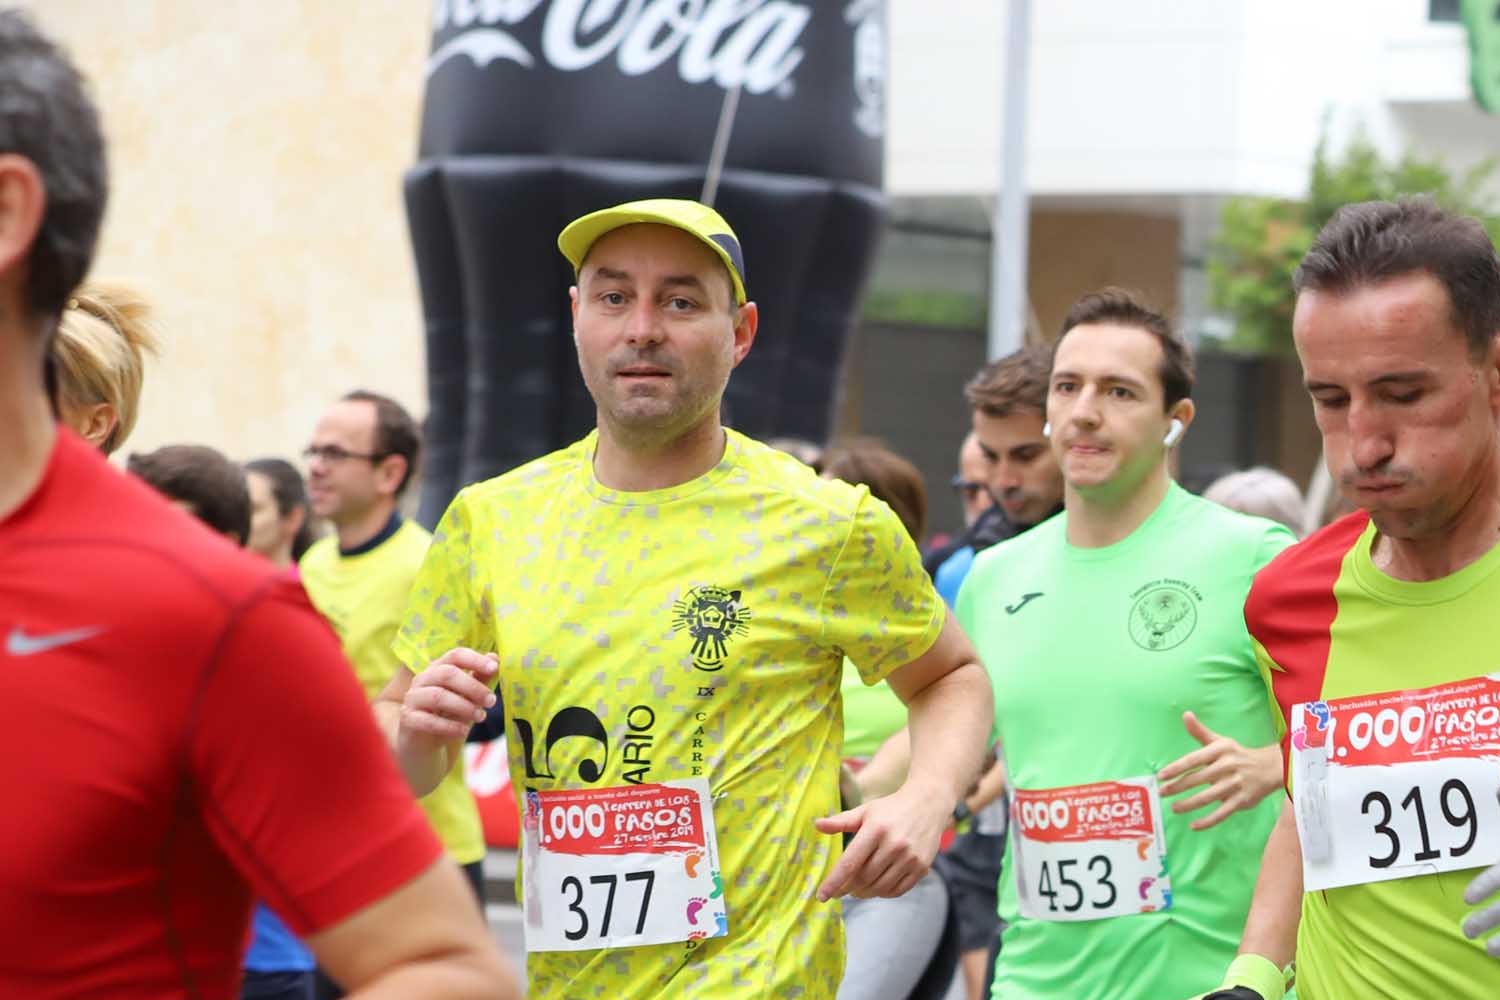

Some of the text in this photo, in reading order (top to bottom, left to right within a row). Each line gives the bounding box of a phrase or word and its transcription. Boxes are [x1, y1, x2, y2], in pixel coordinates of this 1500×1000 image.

[1431, 736, 1446, 749] 27
[654, 798, 666, 807] DE
[668, 795, 690, 805] LOS
[1077, 800, 1144, 823] PASOS
[614, 806, 692, 833] PASOS
[1360, 778, 1478, 868] 319
[613, 833, 628, 845] 27
[1038, 854, 1117, 912] 453
[560, 870, 656, 941] 377
